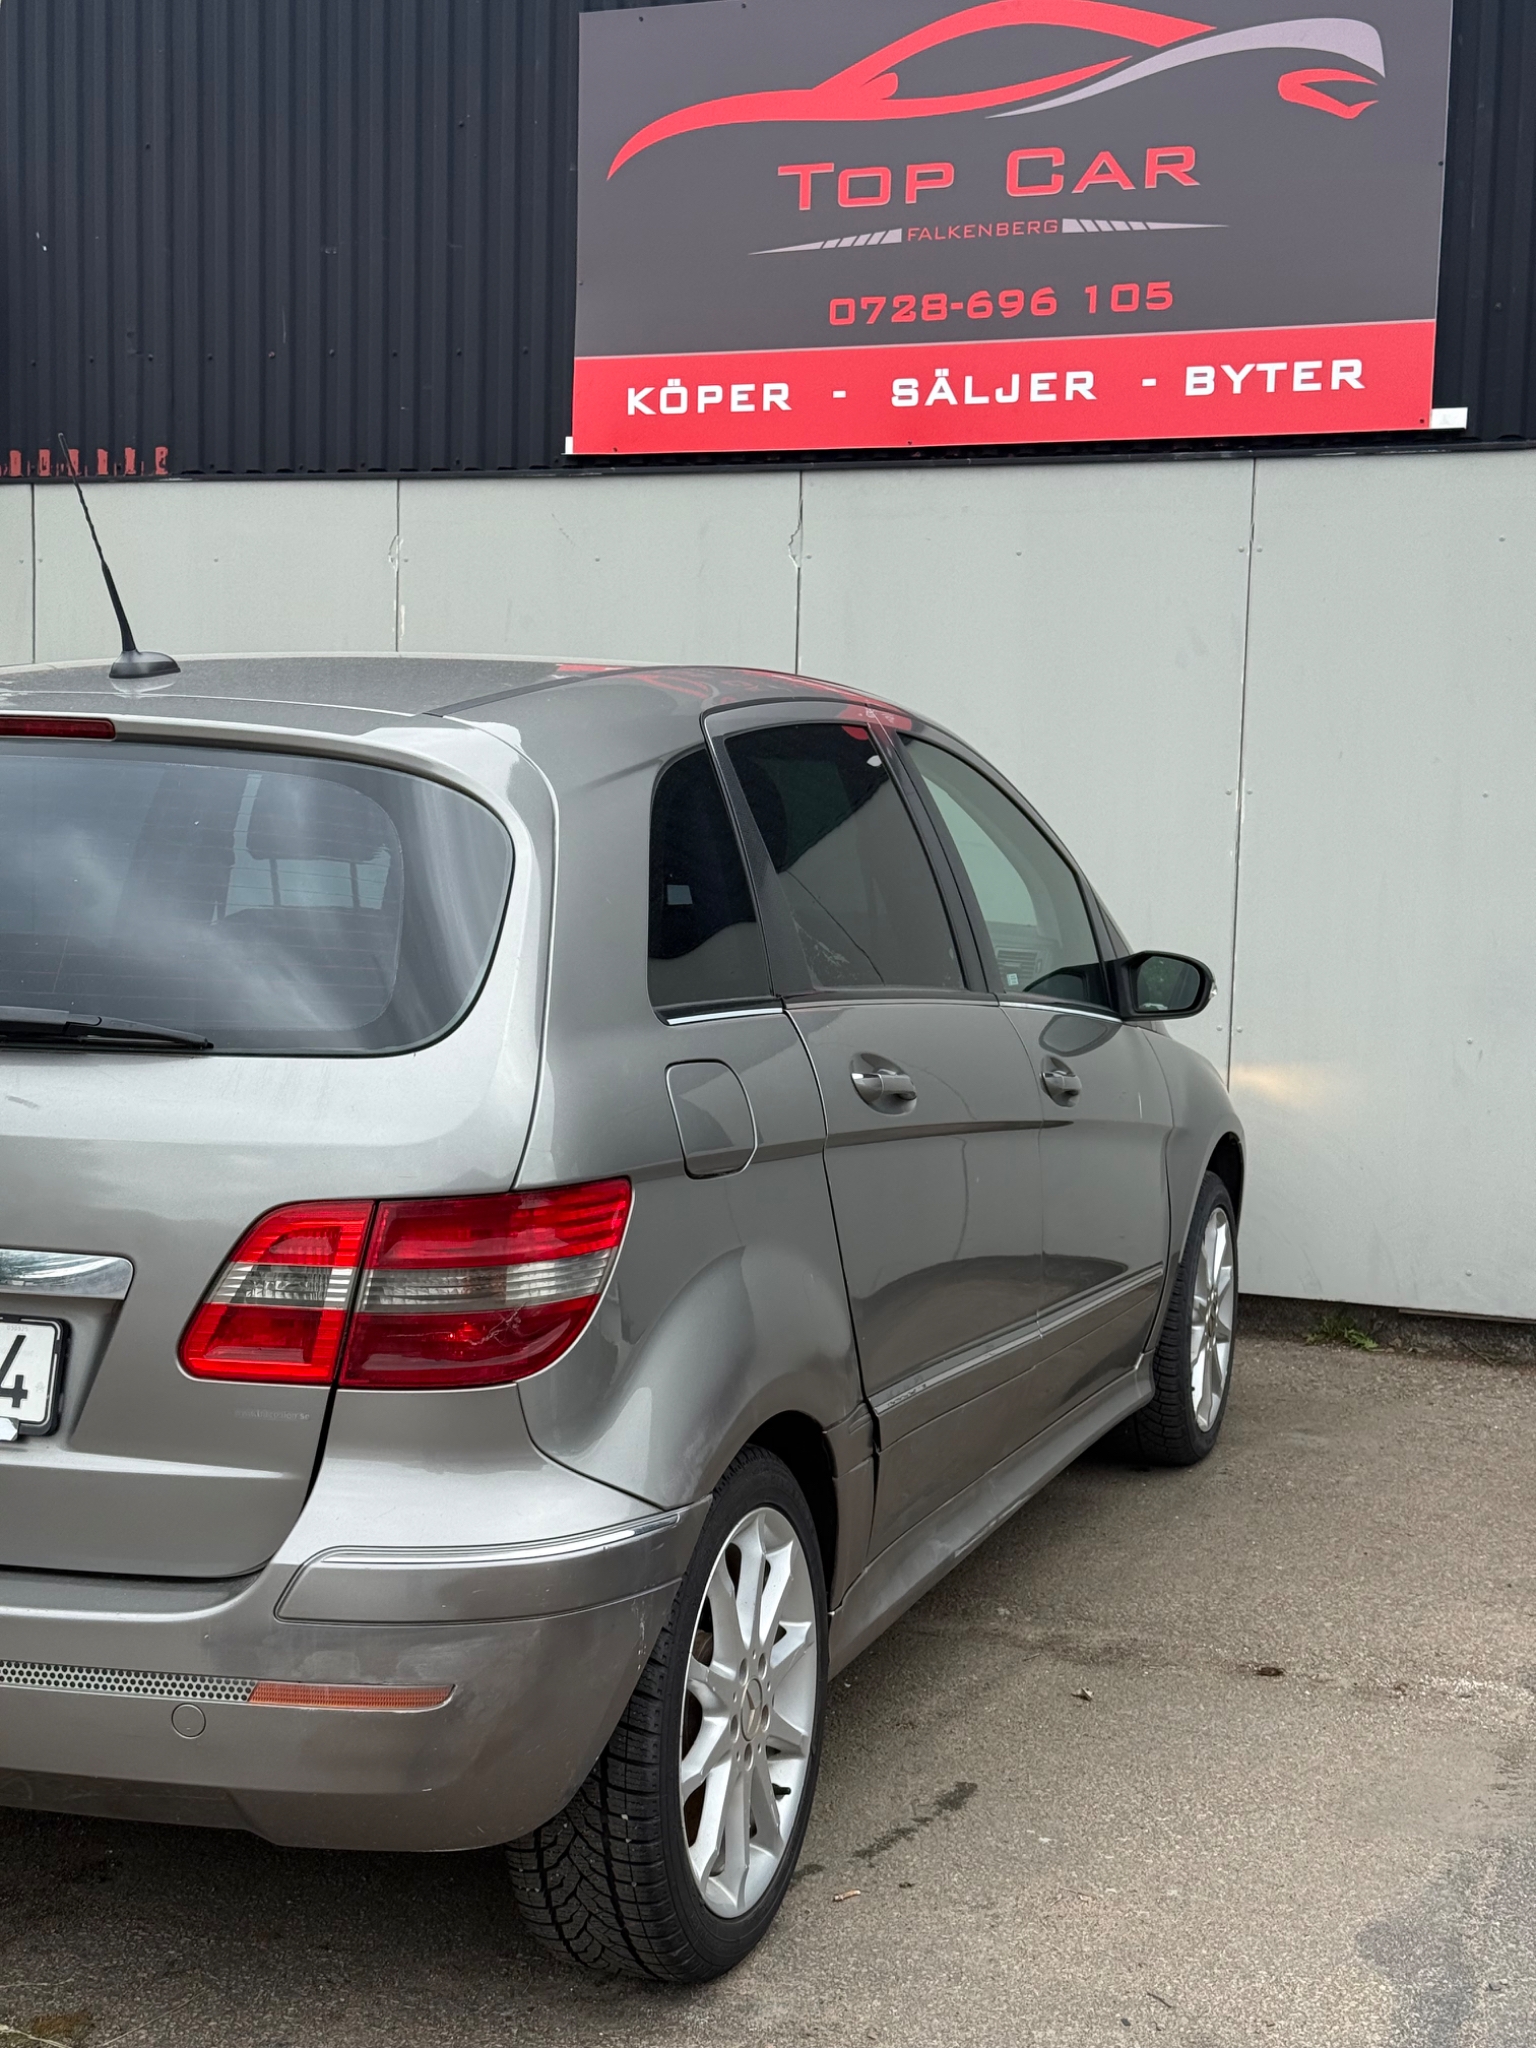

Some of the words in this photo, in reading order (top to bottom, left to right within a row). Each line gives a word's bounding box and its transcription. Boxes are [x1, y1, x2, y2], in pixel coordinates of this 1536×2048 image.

[777, 161, 955, 211] TOP
[1005, 145, 1201, 198] CAR
[906, 218, 1060, 243] FALKENBERG
[828, 285, 1058, 327] 0728-696
[1083, 280, 1174, 315] 105
[627, 378, 791, 415] KÖPER
[891, 368, 1096, 407] SÄLJER
[1185, 359, 1365, 396] BYTER
[0, 1334, 28, 1408] 4
